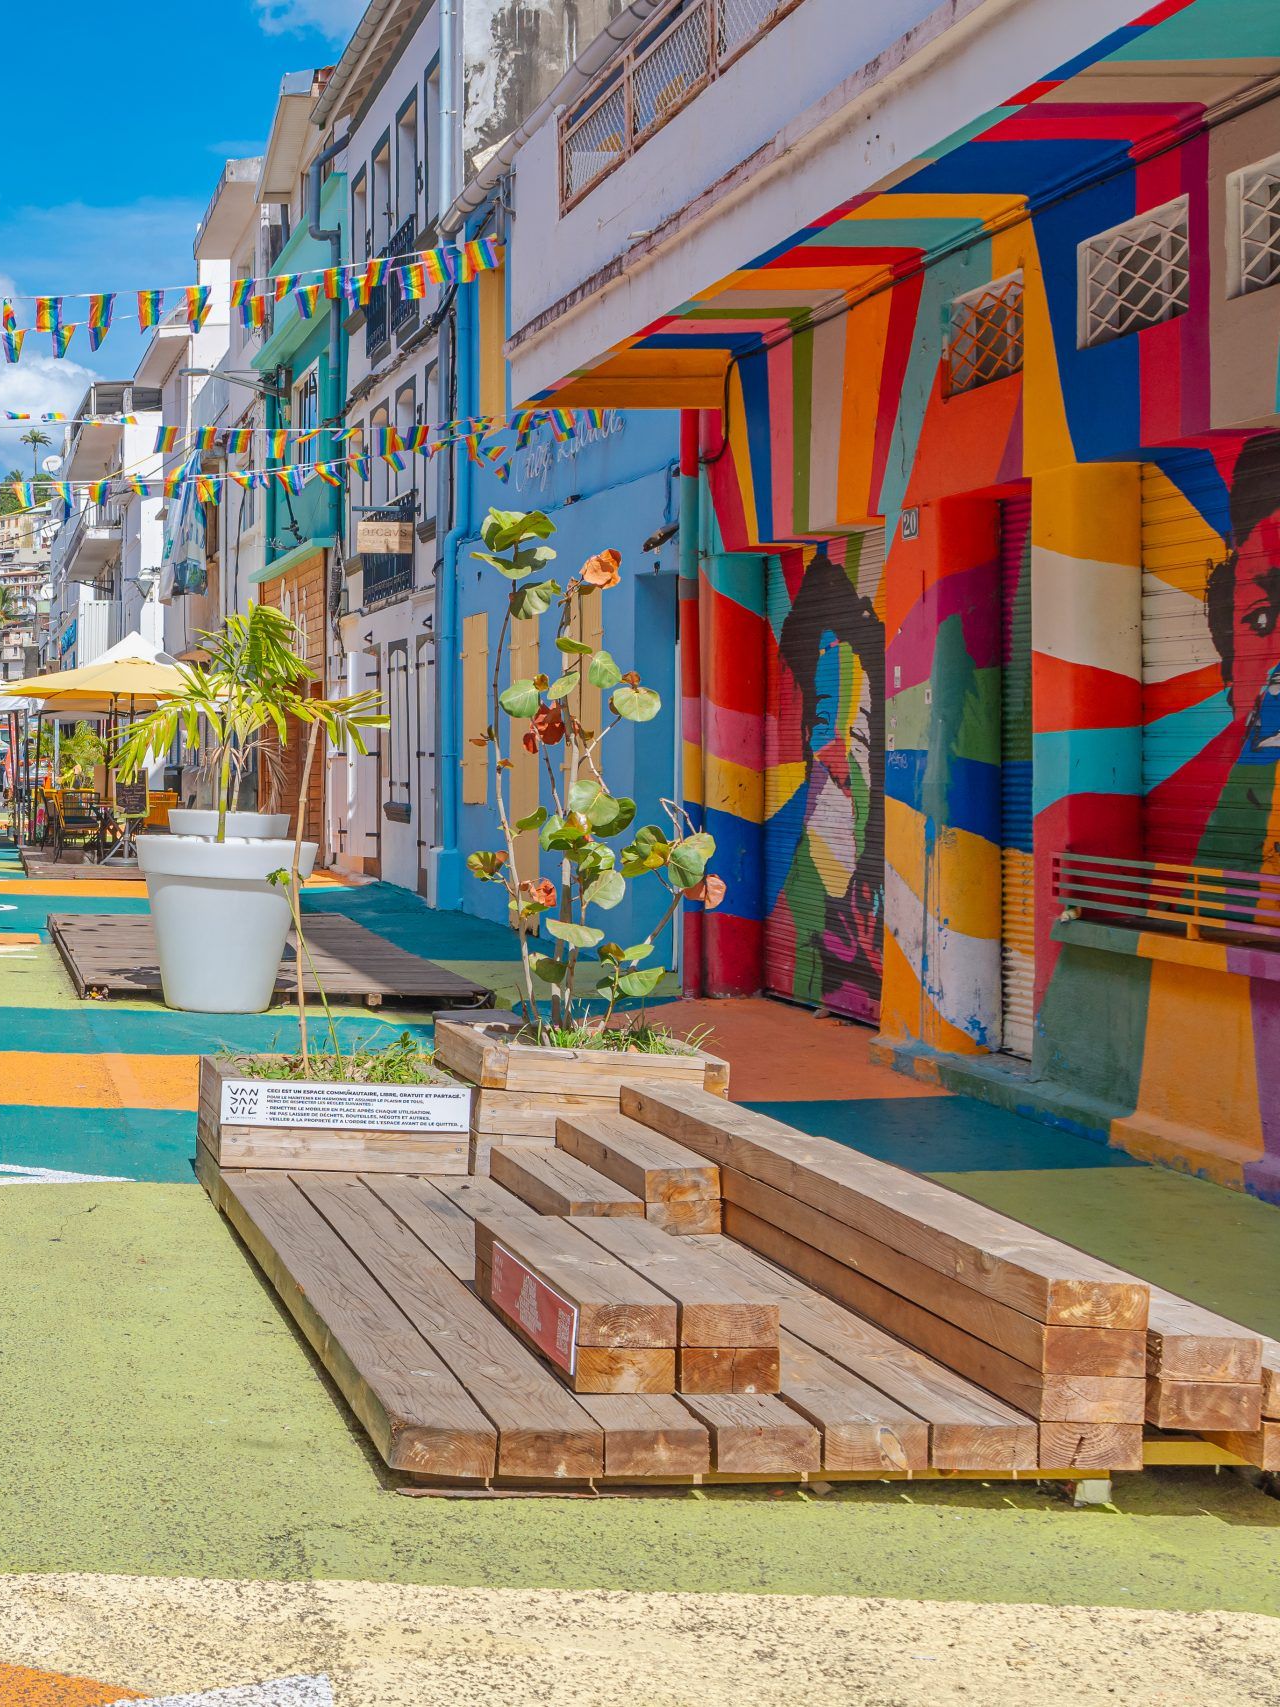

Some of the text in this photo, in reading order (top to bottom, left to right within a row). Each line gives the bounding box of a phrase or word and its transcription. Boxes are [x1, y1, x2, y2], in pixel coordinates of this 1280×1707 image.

[903, 512, 916, 535] 20
[229, 1087, 259, 1096] VAN
[230, 1106, 257, 1115] VIL
